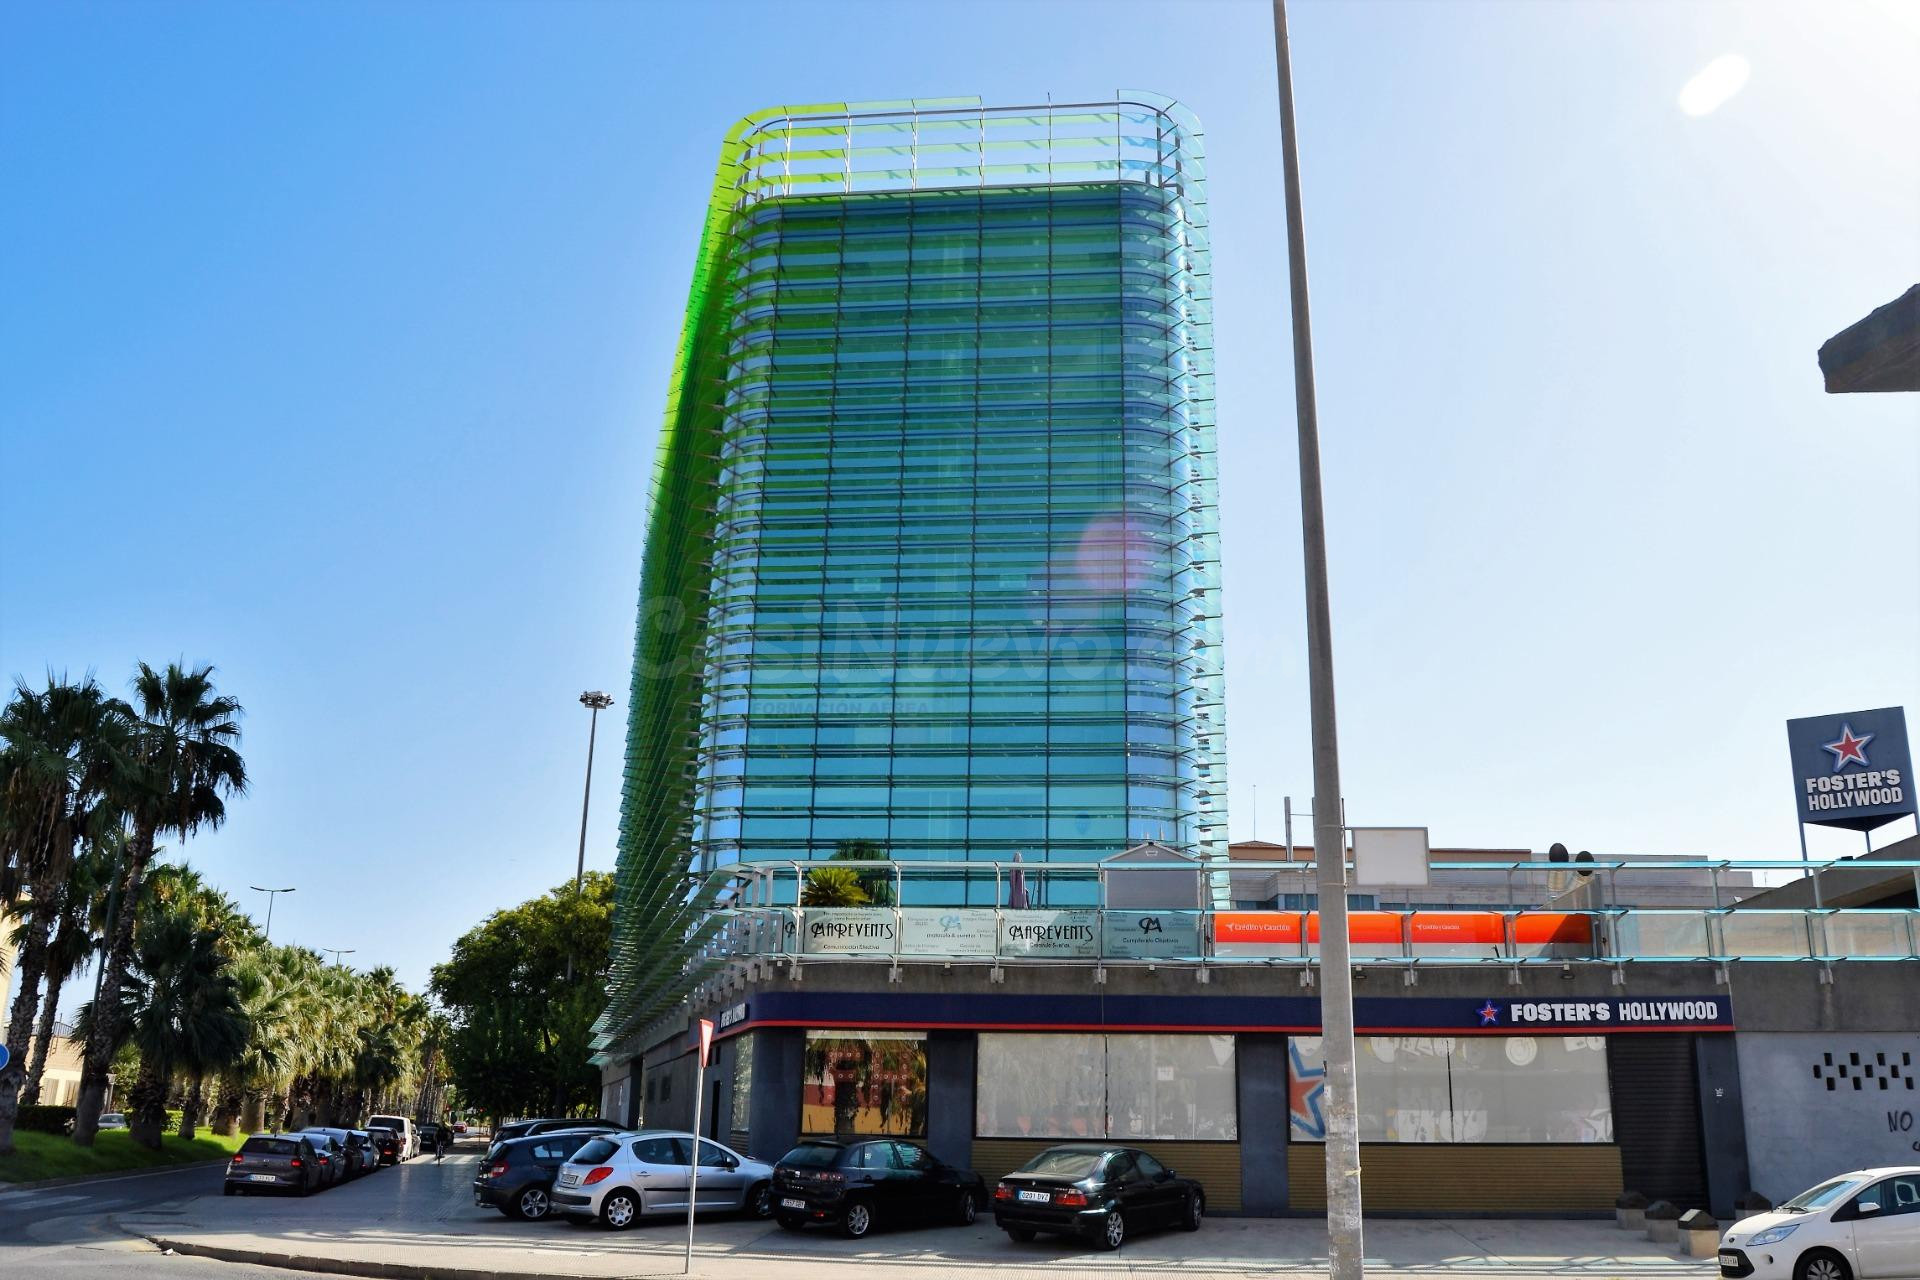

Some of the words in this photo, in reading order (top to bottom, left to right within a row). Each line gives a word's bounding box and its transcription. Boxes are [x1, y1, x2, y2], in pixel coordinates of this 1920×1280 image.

[1806, 769, 1901, 794] FOSTER'S
[1807, 786, 1903, 811] HOLLYWOOD
[1510, 1002, 1611, 1022] FOSTER'S
[1619, 1001, 1718, 1021] HOLLYWOOD
[1887, 1109, 1913, 1133] NO
